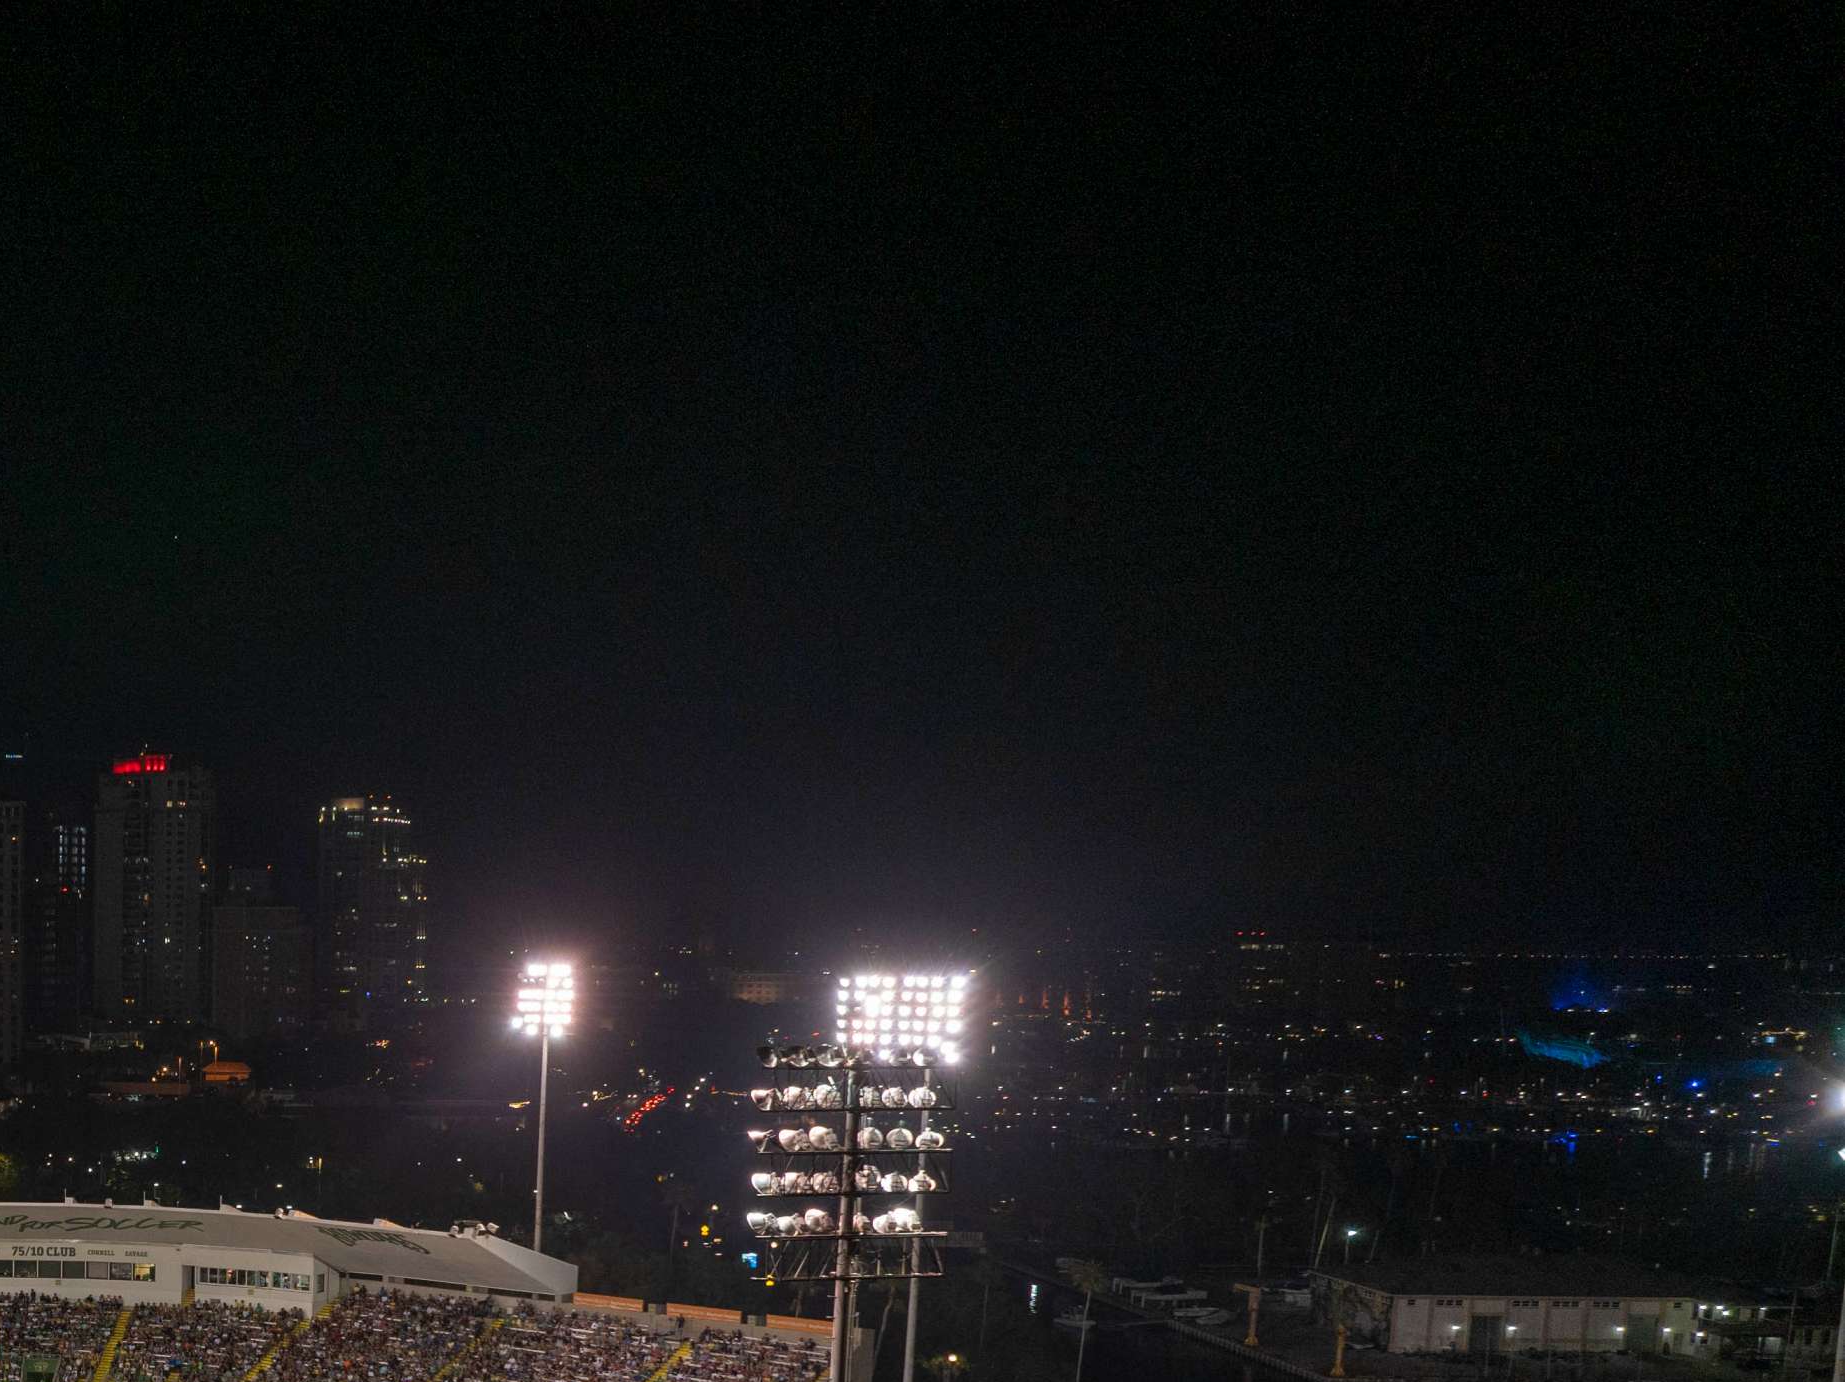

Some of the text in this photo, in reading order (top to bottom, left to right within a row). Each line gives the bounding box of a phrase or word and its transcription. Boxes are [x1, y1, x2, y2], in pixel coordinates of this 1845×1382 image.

[19, 1219, 63, 1233] FOR
[61, 1217, 205, 1233] SOCCER
[11, 1245, 77, 1258] 75/10 CLUB
